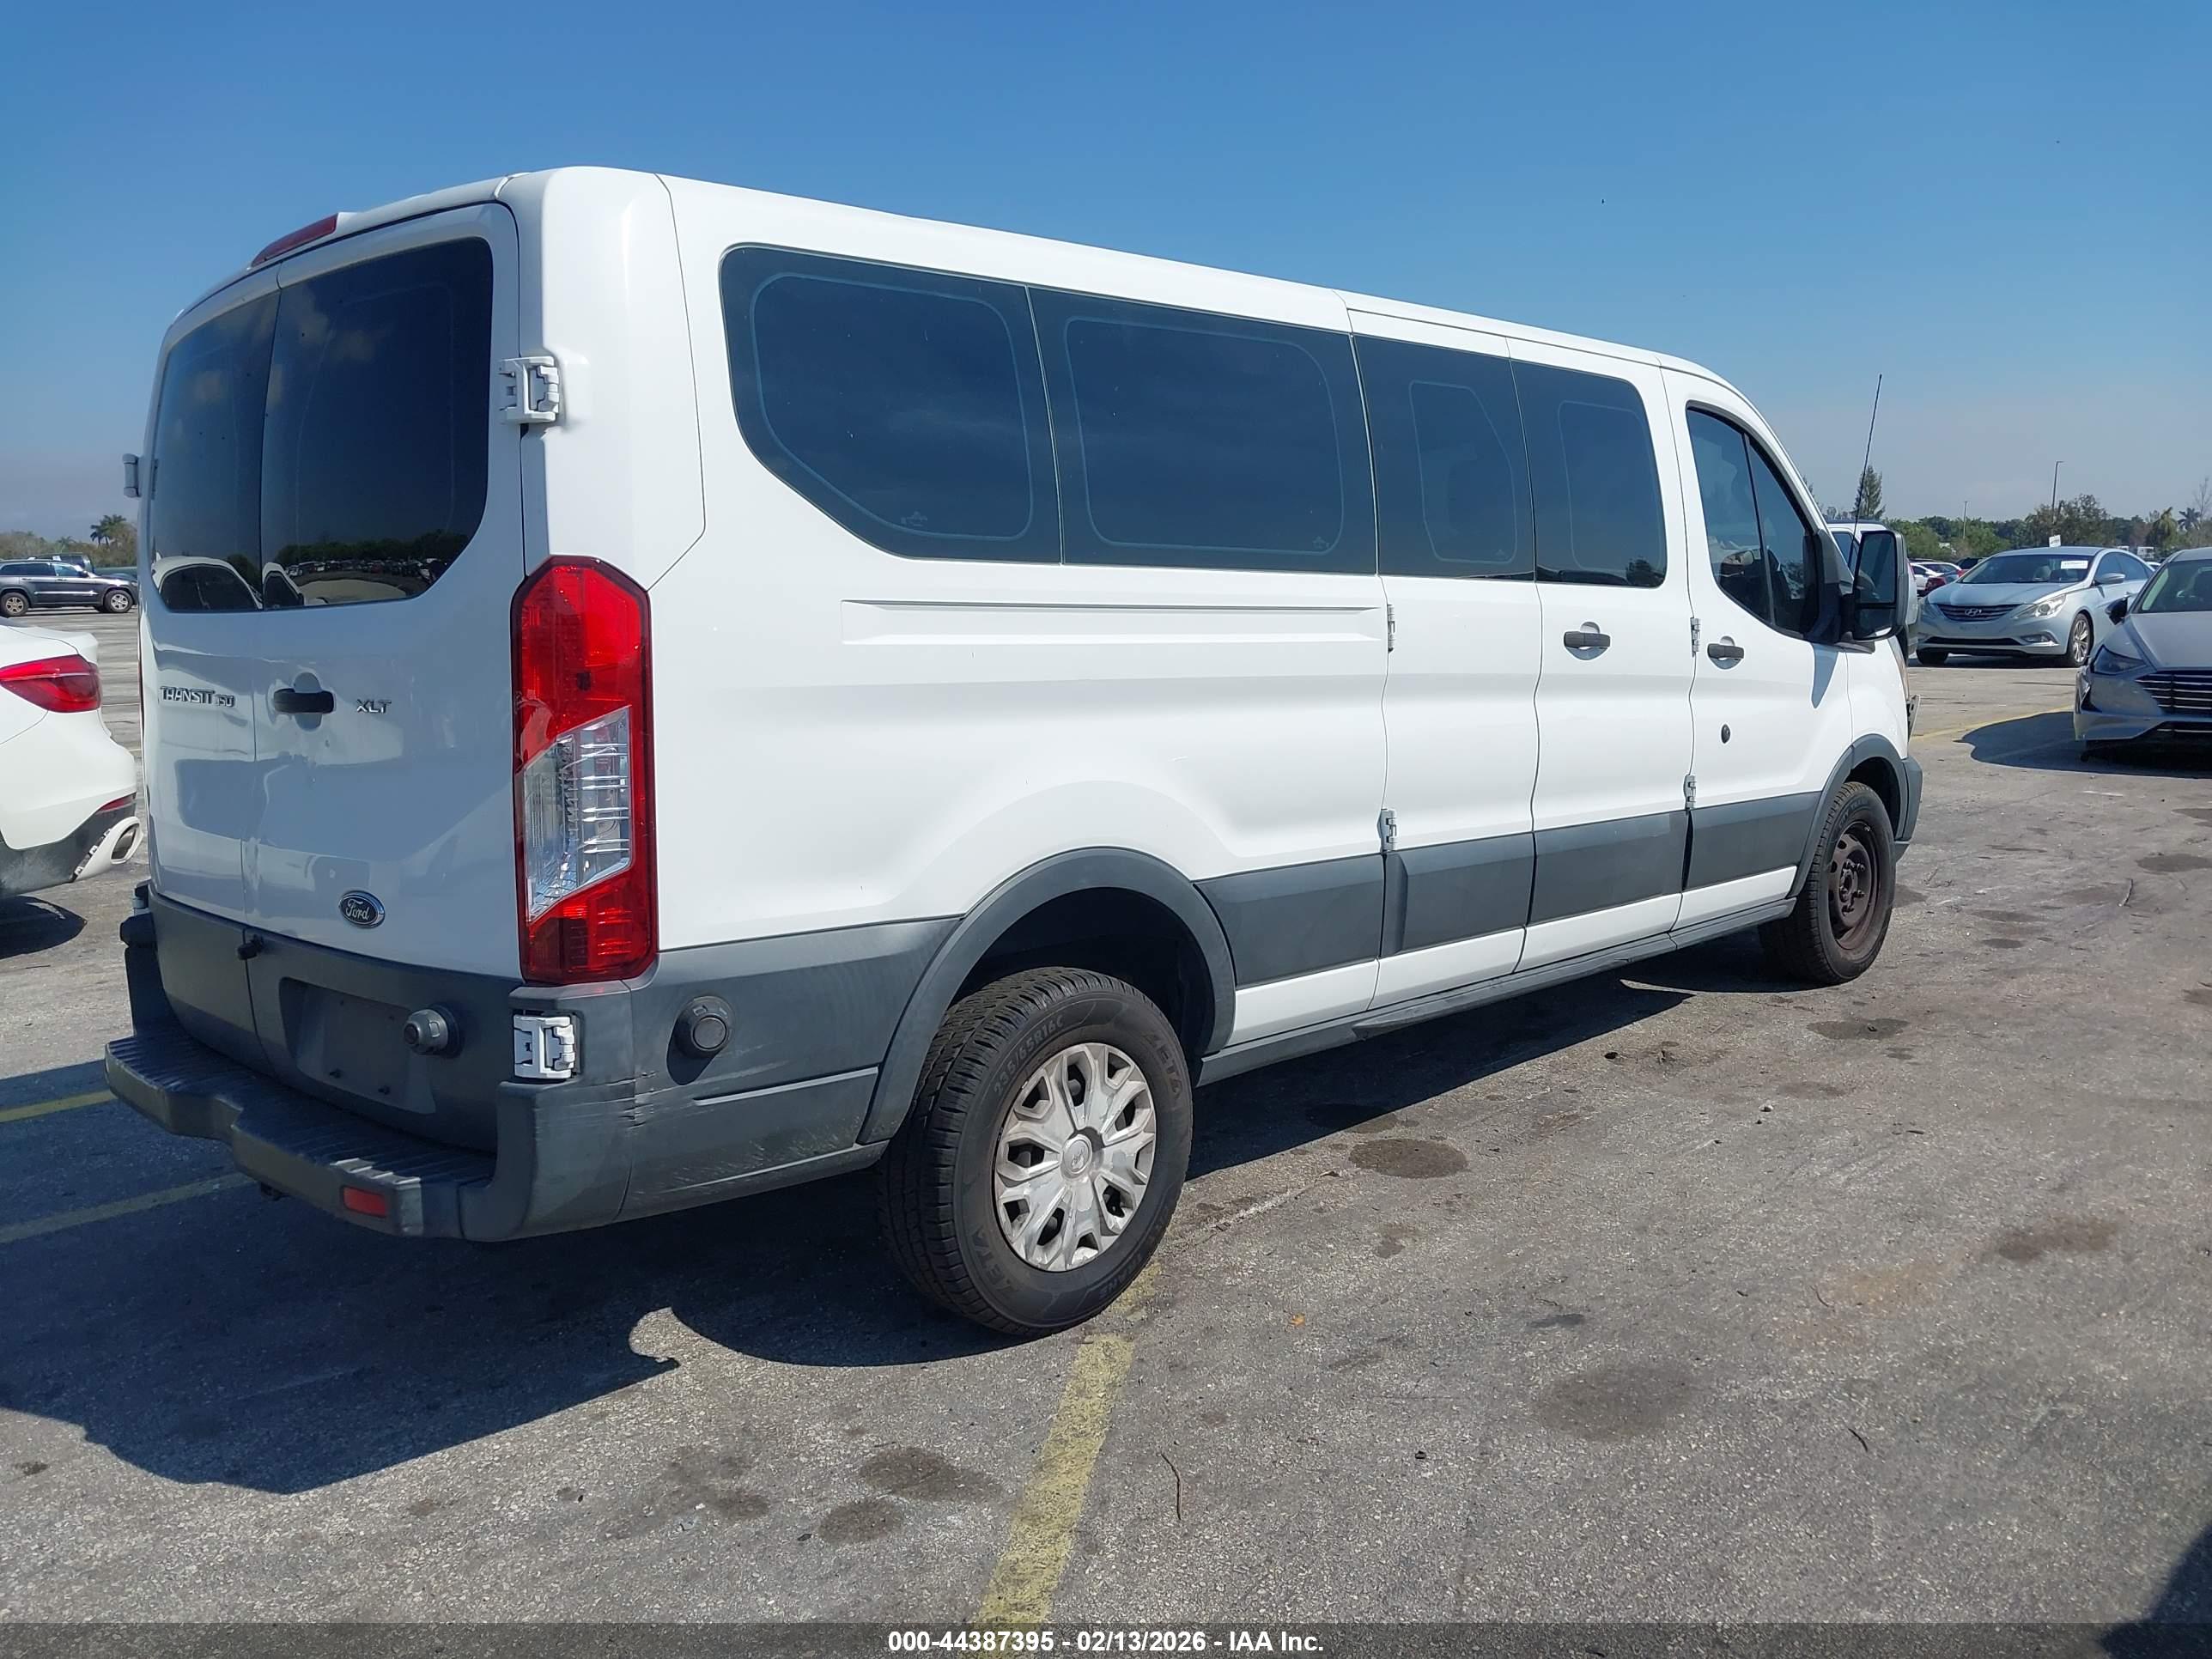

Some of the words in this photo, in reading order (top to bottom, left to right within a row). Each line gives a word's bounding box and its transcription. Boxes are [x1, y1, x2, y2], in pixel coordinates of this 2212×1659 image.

[160, 686, 216, 704] TRANSIT
[356, 699, 392, 714] XLT
[345, 898, 370, 921] Ford
[994, 1015, 1064, 1097] 235/65R16C
